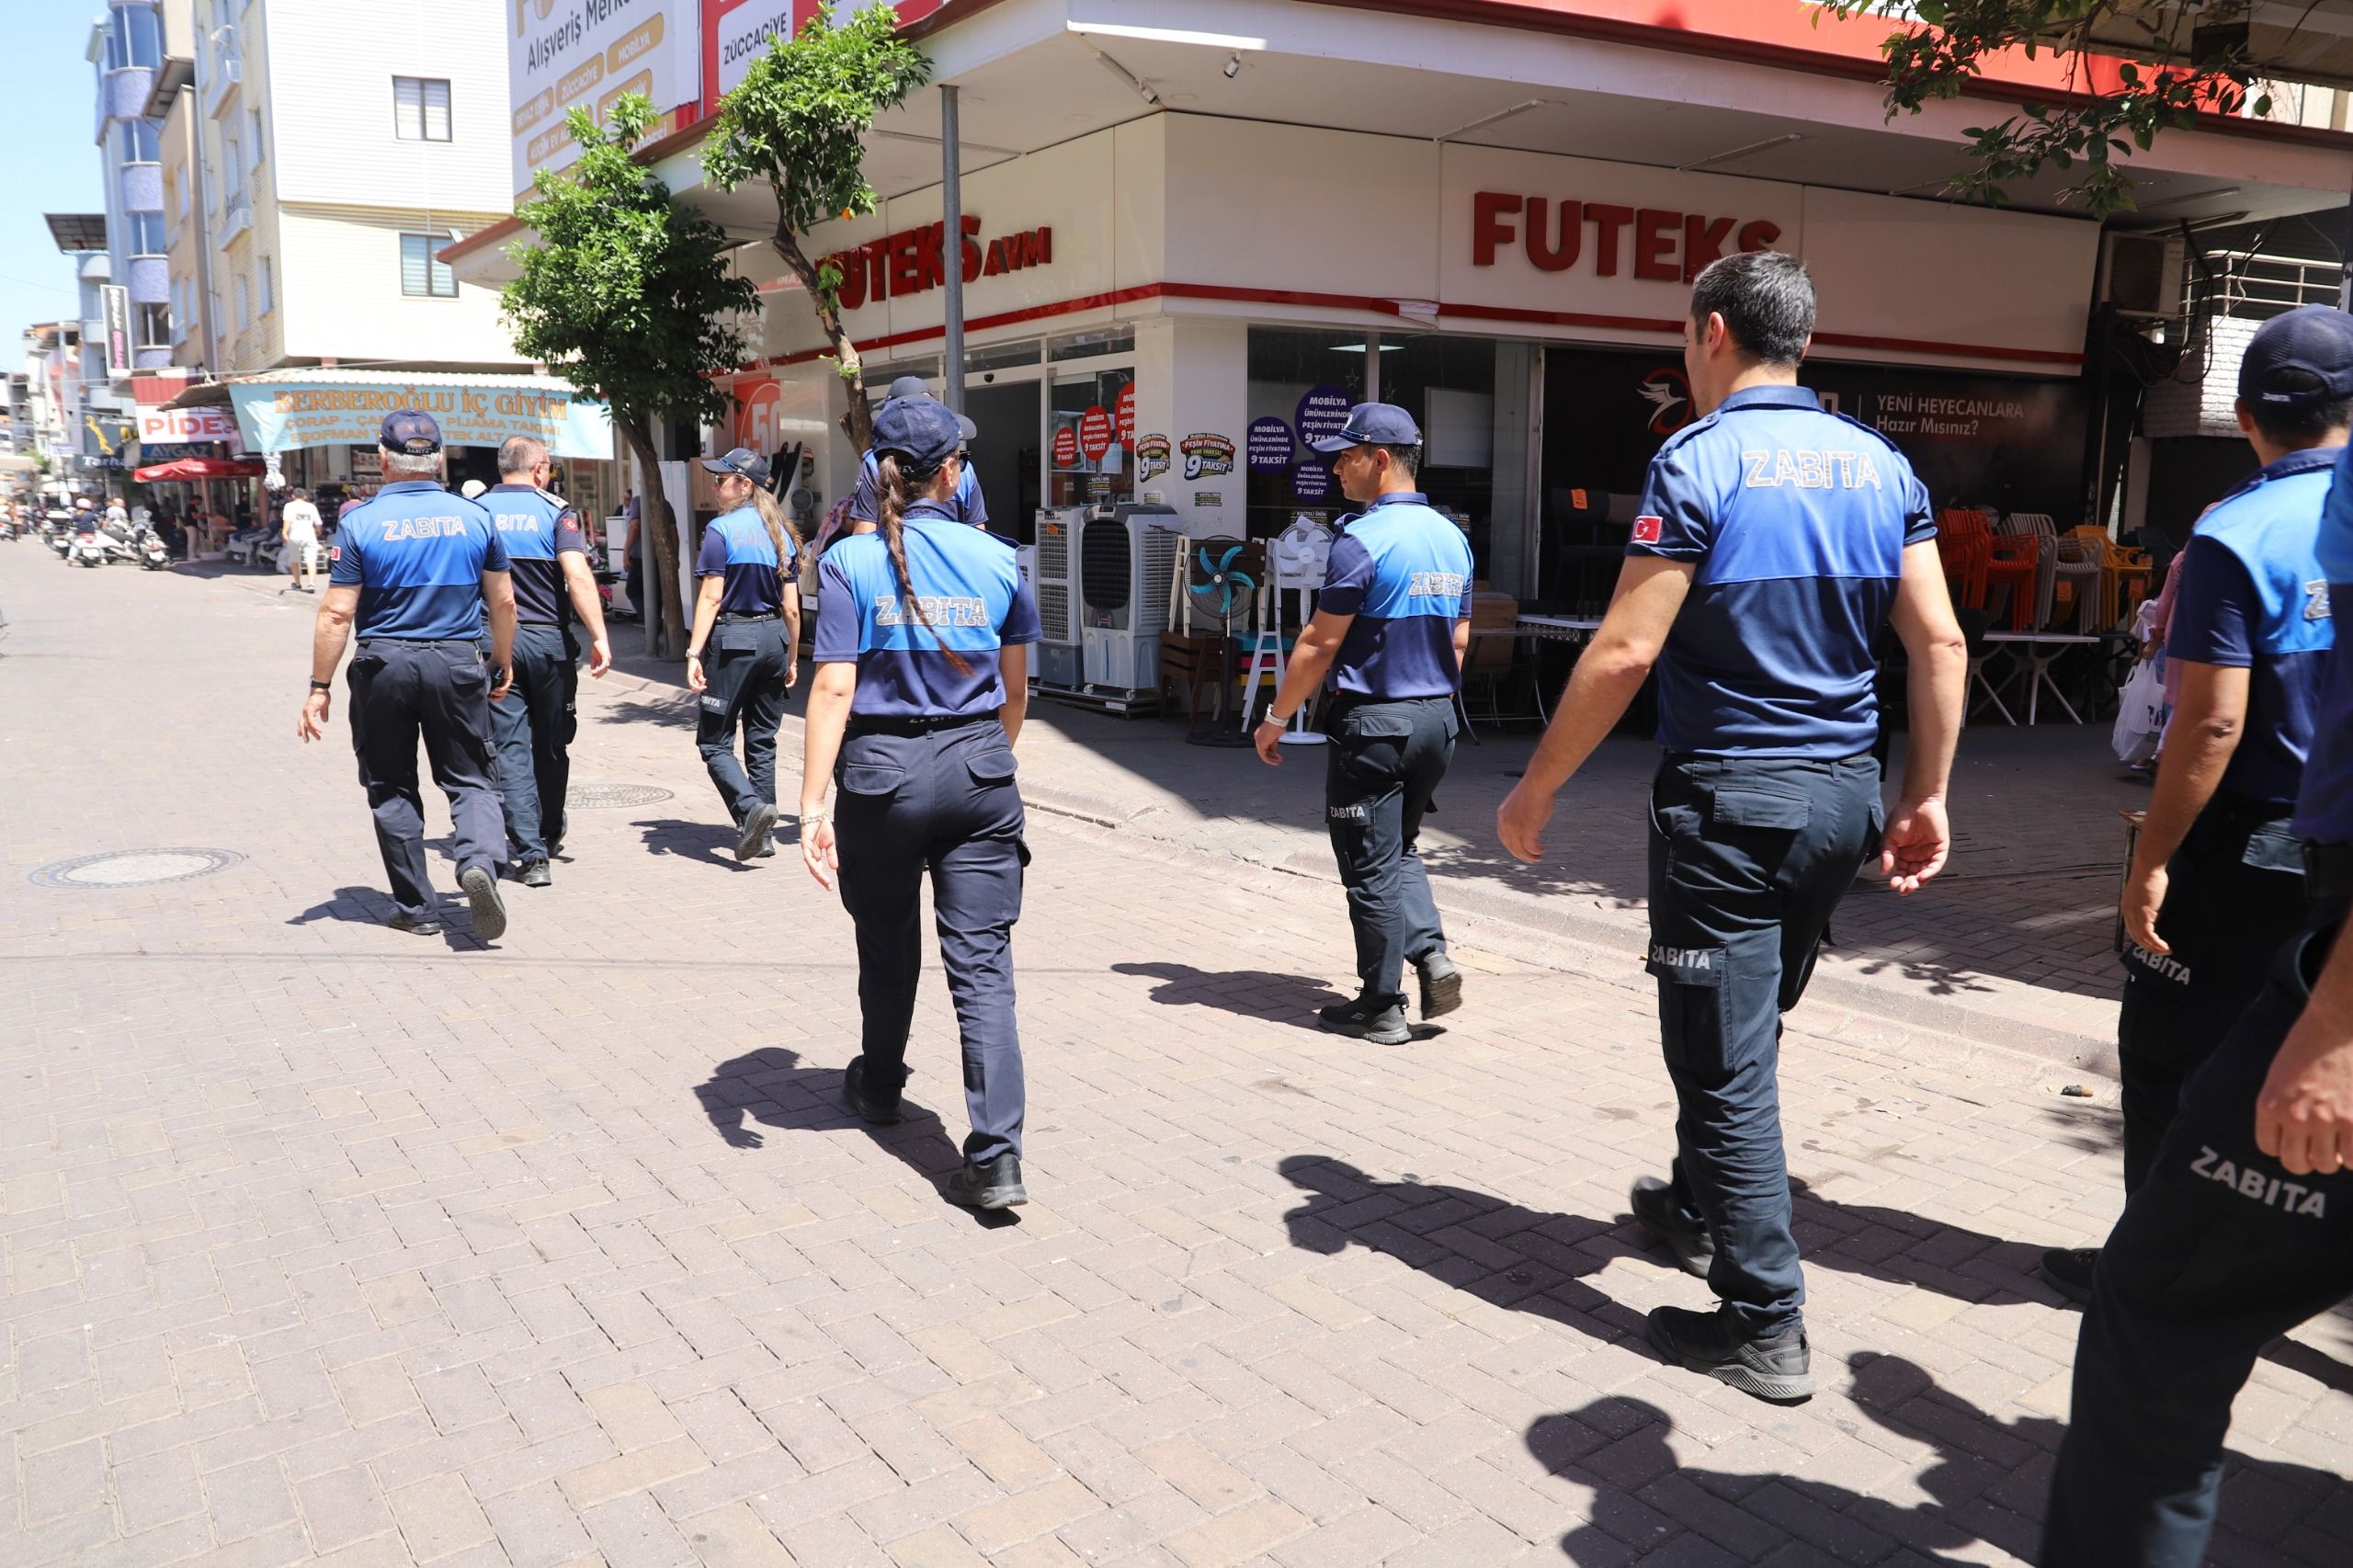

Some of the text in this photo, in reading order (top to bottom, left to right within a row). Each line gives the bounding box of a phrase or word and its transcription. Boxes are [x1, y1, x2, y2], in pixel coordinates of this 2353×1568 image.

[528, 9, 582, 75] Alışveriş
[617, 30, 651, 64] MOBİLYA
[723, 12, 788, 65] ZÜCCACİYE
[983, 226, 1052, 277] AVM
[273, 384, 567, 420] BERBEROĞLU İÇ GİYİM
[1309, 395, 1347, 406] MOBİLYA
[1877, 392, 2024, 418] YENİ HEYECANLARA
[143, 413, 223, 436] PİDE
[285, 415, 339, 430] ÇORAP
[446, 416, 506, 429] PİJAMA
[1254, 425, 1285, 433] MOBİLYA
[1302, 420, 1323, 431] PEŞİN
[1876, 415, 1979, 436] Hazır Mısınız?
[443, 430, 472, 441] TEK
[476, 432, 505, 442] ALT
[1120, 429, 1126, 441] 9
[1250, 435, 1289, 443] ÜRÜNLERİNDE
[1304, 432, 1313, 444] 9
[149, 445, 209, 458] AYGAZ
[1085, 443, 1089, 452] 9
[1184, 439, 1231, 450] PEŞİN FİYATINA
[1248, 444, 1290, 453] PEŞİN FİYATINA
[1185, 455, 1202, 480] 9
[1251, 454, 1288, 464] 9 TAKSİT
[1300, 464, 1324, 472] MOBİLYA
[1141, 457, 1151, 481] 9
[1742, 449, 1882, 491] ZABITA
[381, 517, 467, 541] ZABITA
[875, 596, 988, 627] ZABITA
[2188, 1144, 2326, 1219] ZABITA
